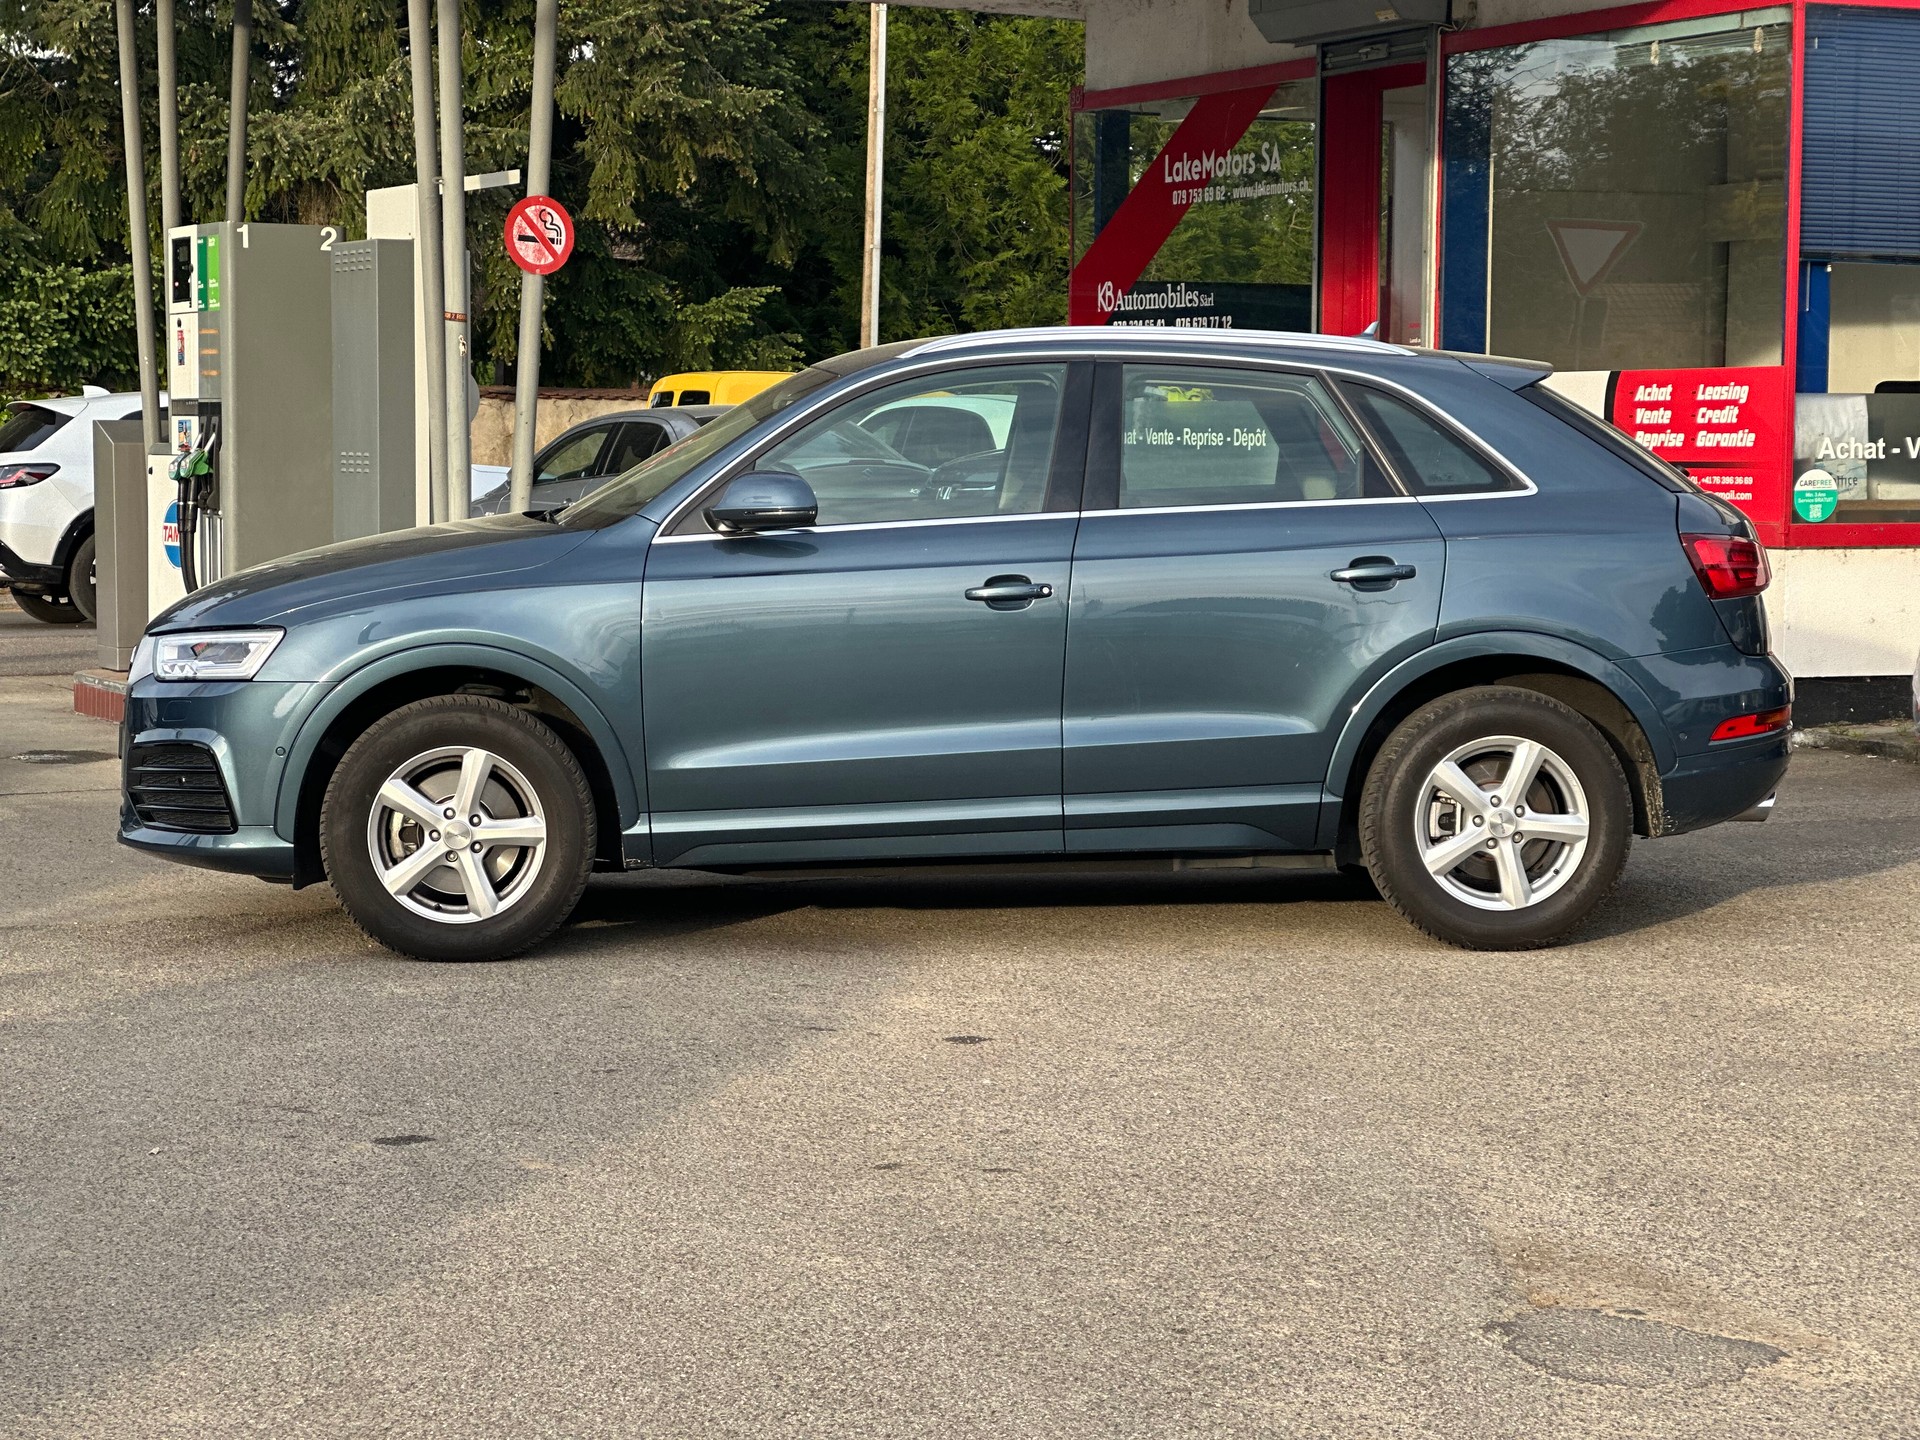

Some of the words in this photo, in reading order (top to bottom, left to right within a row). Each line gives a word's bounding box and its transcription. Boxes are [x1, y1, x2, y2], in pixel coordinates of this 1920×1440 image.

[1164, 149, 1256, 183] LakeMotors
[1261, 141, 1281, 173] SA
[1172, 189, 1186, 205] 079
[1188, 188, 1202, 203] 753
[1204, 187, 1214, 202] 69
[1215, 186, 1225, 201] 62
[236, 224, 249, 248] 1
[320, 226, 337, 251] 2
[1097, 281, 1114, 312] KB
[1114, 283, 1199, 311] Automobiles
[1221, 315, 1233, 329] 12
[1634, 384, 1673, 401] Achat
[1696, 382, 1750, 404] Leasing
[1635, 407, 1672, 424] Vente
[1696, 405, 1739, 424] Credit
[1145, 427, 1174, 445] Vente
[1183, 427, 1224, 450] Reprise
[1233, 427, 1267, 451] Dépôt
[1635, 429, 1685, 450] Reprise
[1696, 429, 1756, 447] Garantie
[1817, 436, 1886, 459] Achat
